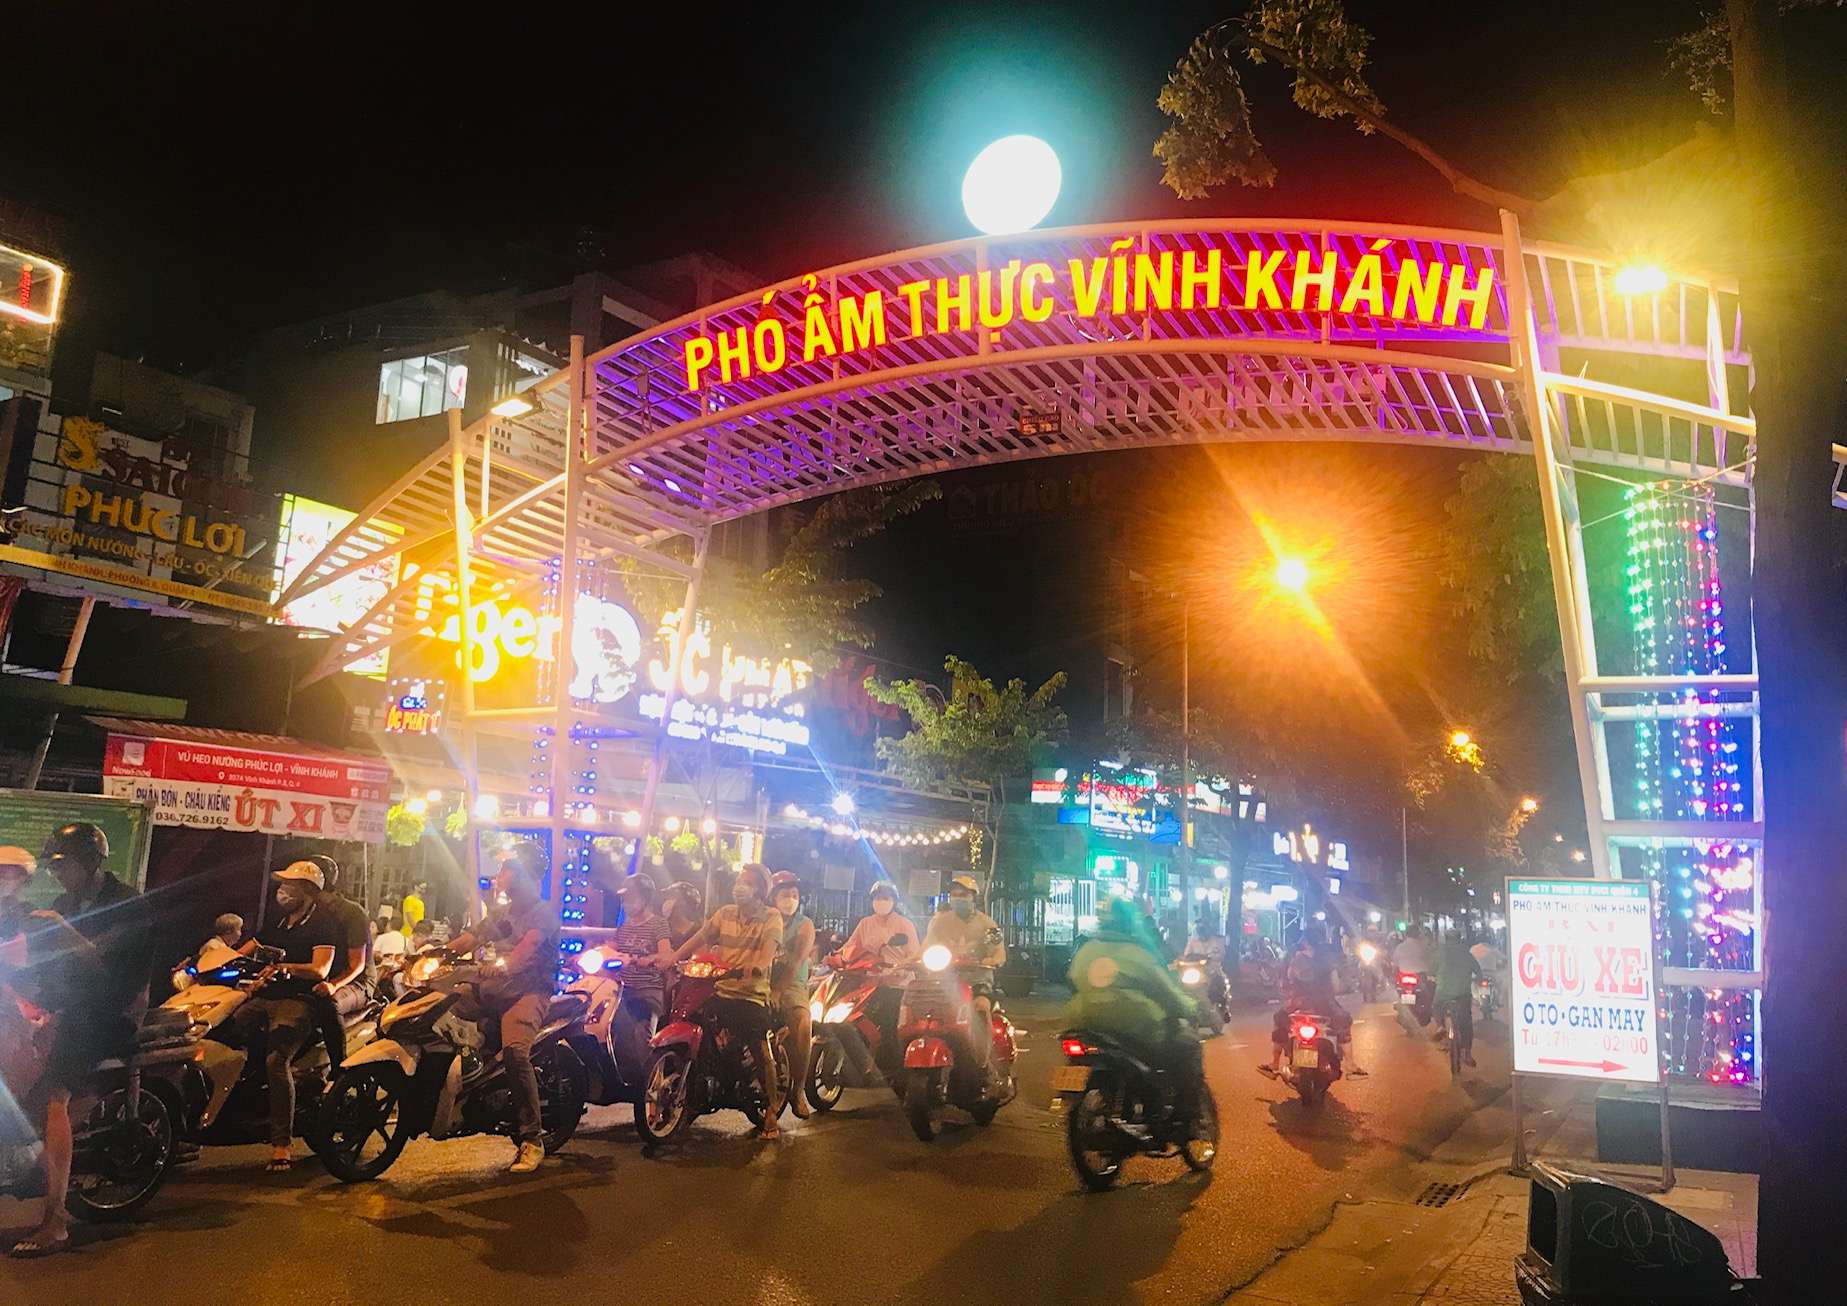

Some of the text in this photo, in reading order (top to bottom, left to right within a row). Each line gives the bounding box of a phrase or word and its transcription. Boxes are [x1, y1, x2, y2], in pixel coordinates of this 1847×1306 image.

[802, 273, 886, 363] ẨM
[899, 260, 1055, 343] THỰC
[1069, 237, 1221, 318] VĨNH
[1244, 239, 1494, 329] KHÁNH
